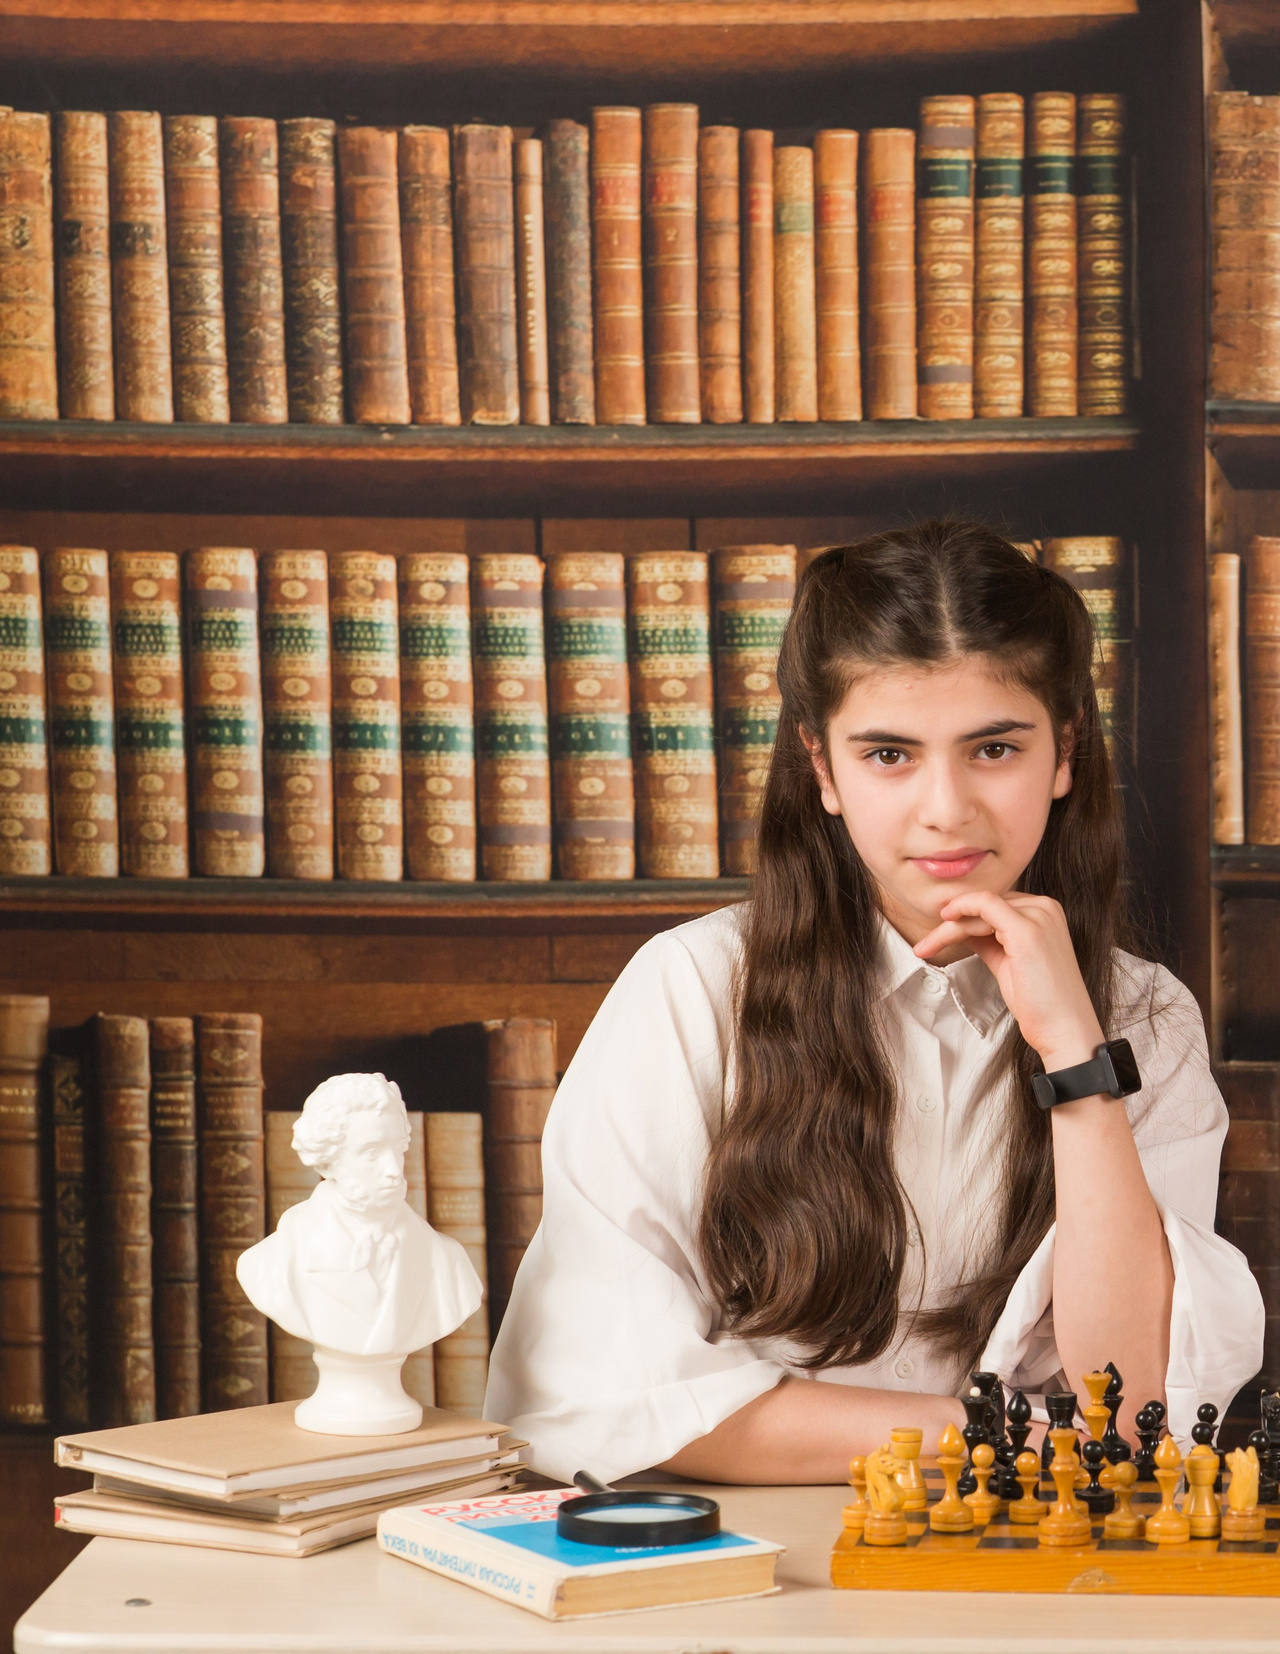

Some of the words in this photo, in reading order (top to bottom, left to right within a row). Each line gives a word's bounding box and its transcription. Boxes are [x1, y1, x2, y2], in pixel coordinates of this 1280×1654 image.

[420, 1489, 588, 1517] РУССКА
[444, 1503, 559, 1523] ЛИТЕРА
[382, 1532, 407, 1553] ВЕКА
[421, 1545, 478, 1579] ЛИТЕРАТУРА
[479, 1565, 522, 1595] РУССКАЯ
